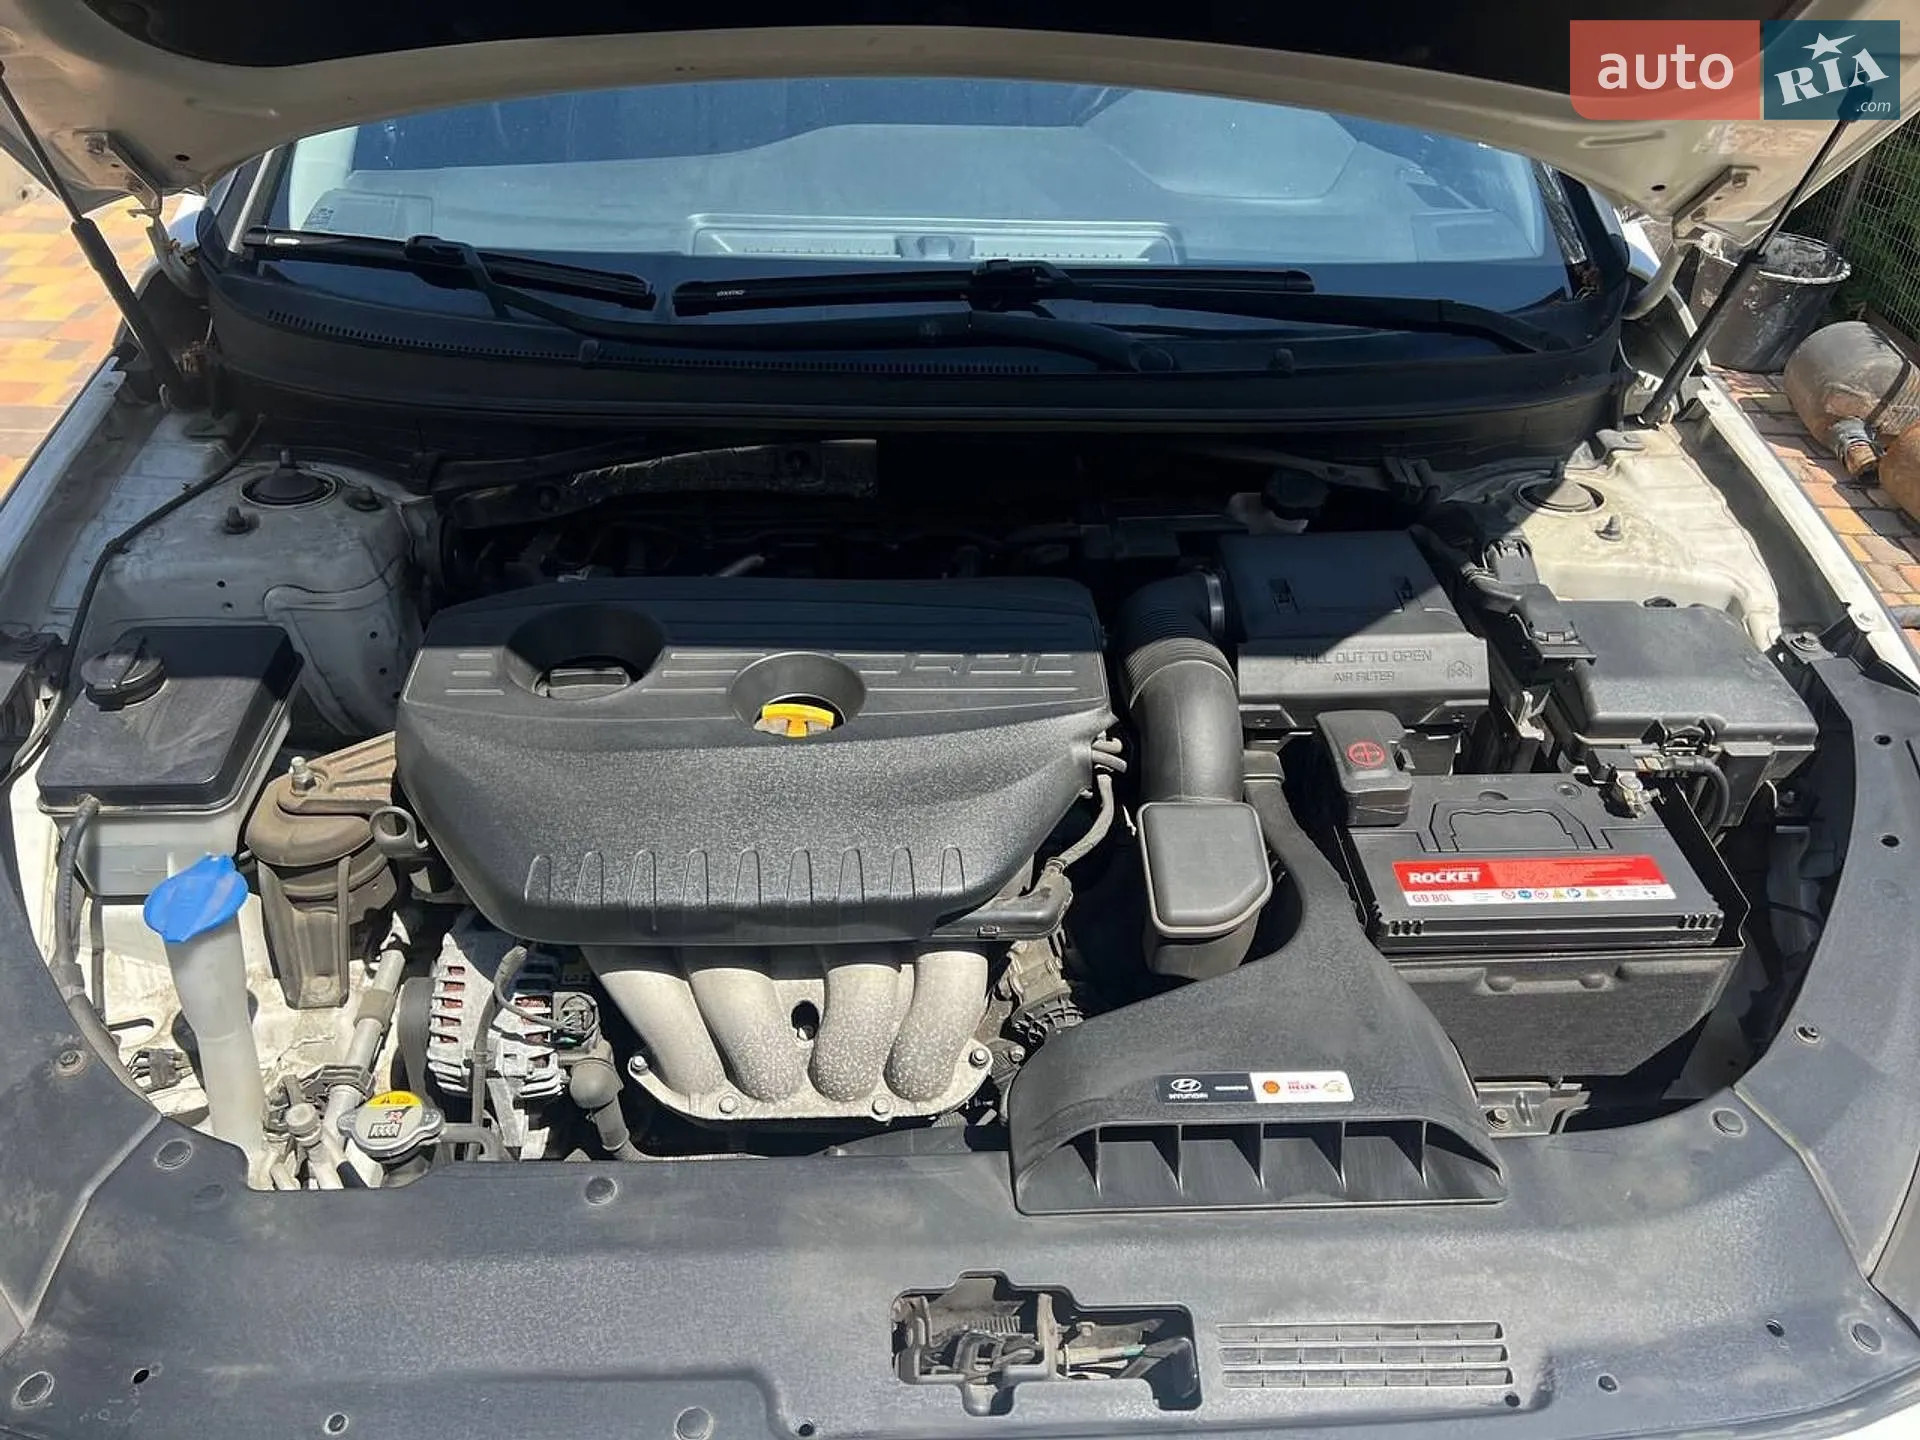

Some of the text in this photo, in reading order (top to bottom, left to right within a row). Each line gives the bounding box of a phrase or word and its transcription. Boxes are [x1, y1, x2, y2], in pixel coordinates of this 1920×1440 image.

[1294, 649, 1432, 665] PULL OUT TO OPEN
[1334, 670, 1395, 682] AIR FILTER
[1408, 871, 1481, 884] ROCKET
